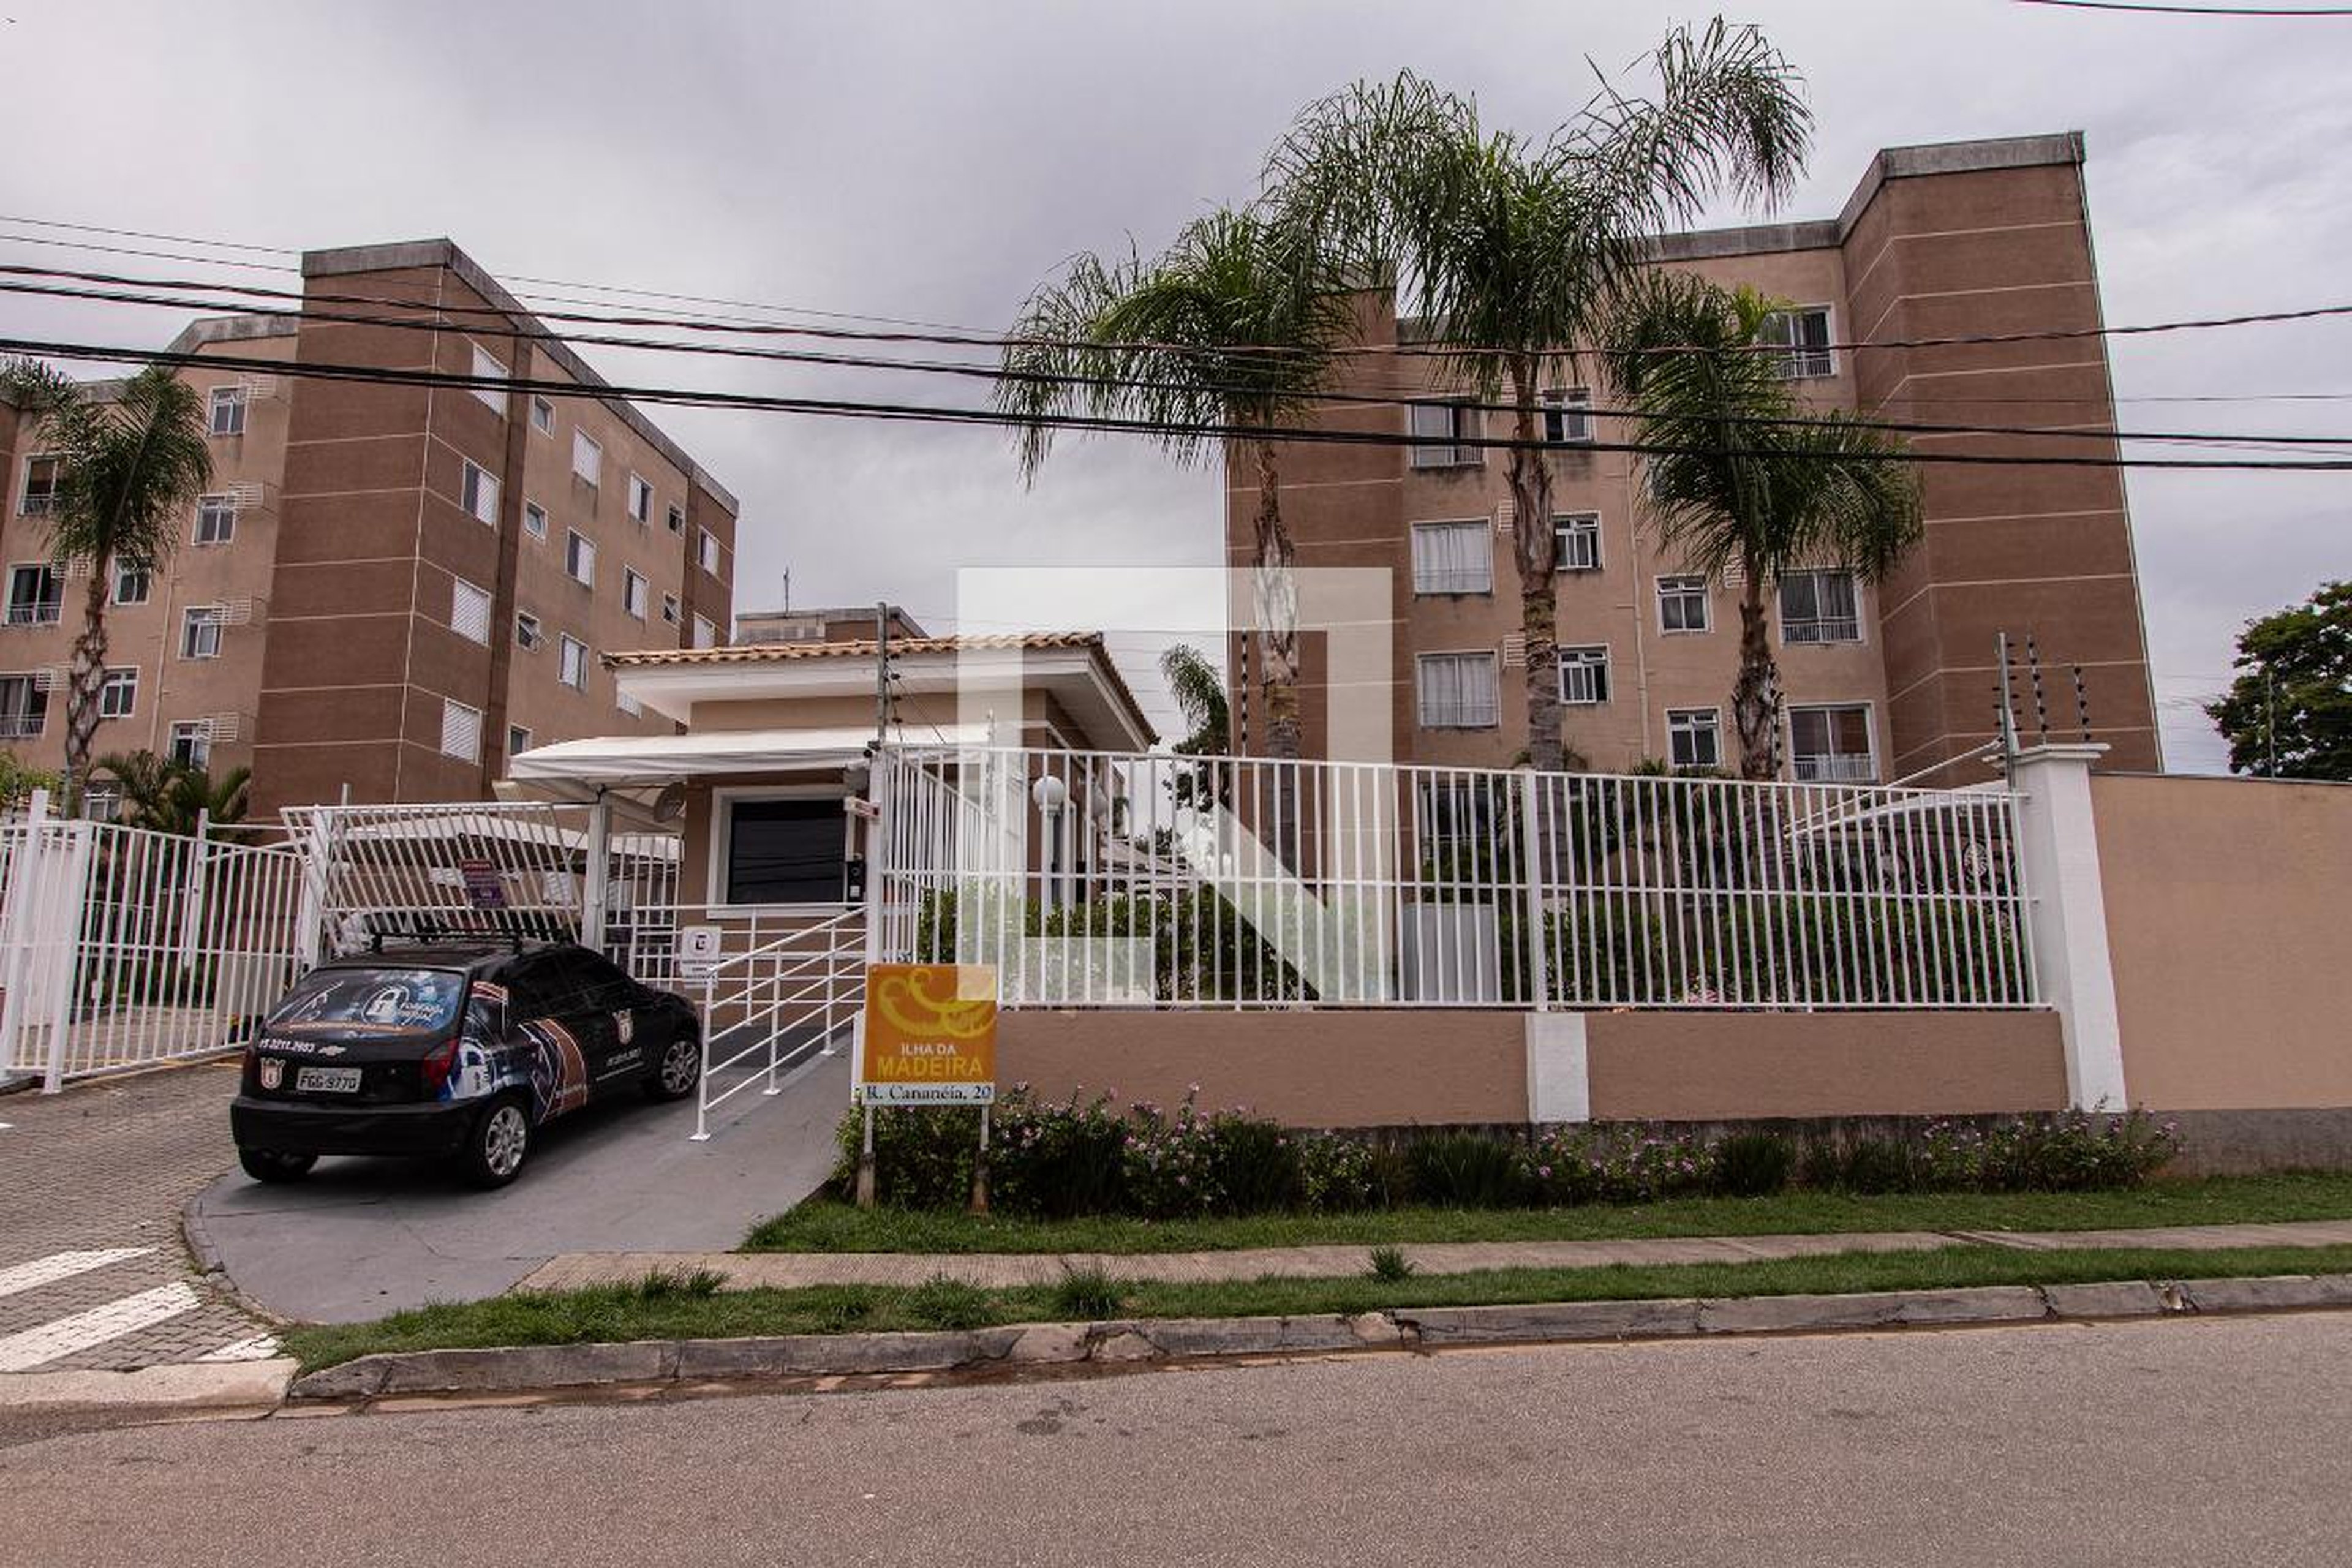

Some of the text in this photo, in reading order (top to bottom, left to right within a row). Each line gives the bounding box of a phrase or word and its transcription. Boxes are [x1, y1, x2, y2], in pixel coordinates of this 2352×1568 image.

[901, 1043, 957, 1055] ILHA DA
[877, 1057, 983, 1078] MADEIRA
[866, 1085, 883, 1099] R.
[973, 1085, 991, 1099] 20
